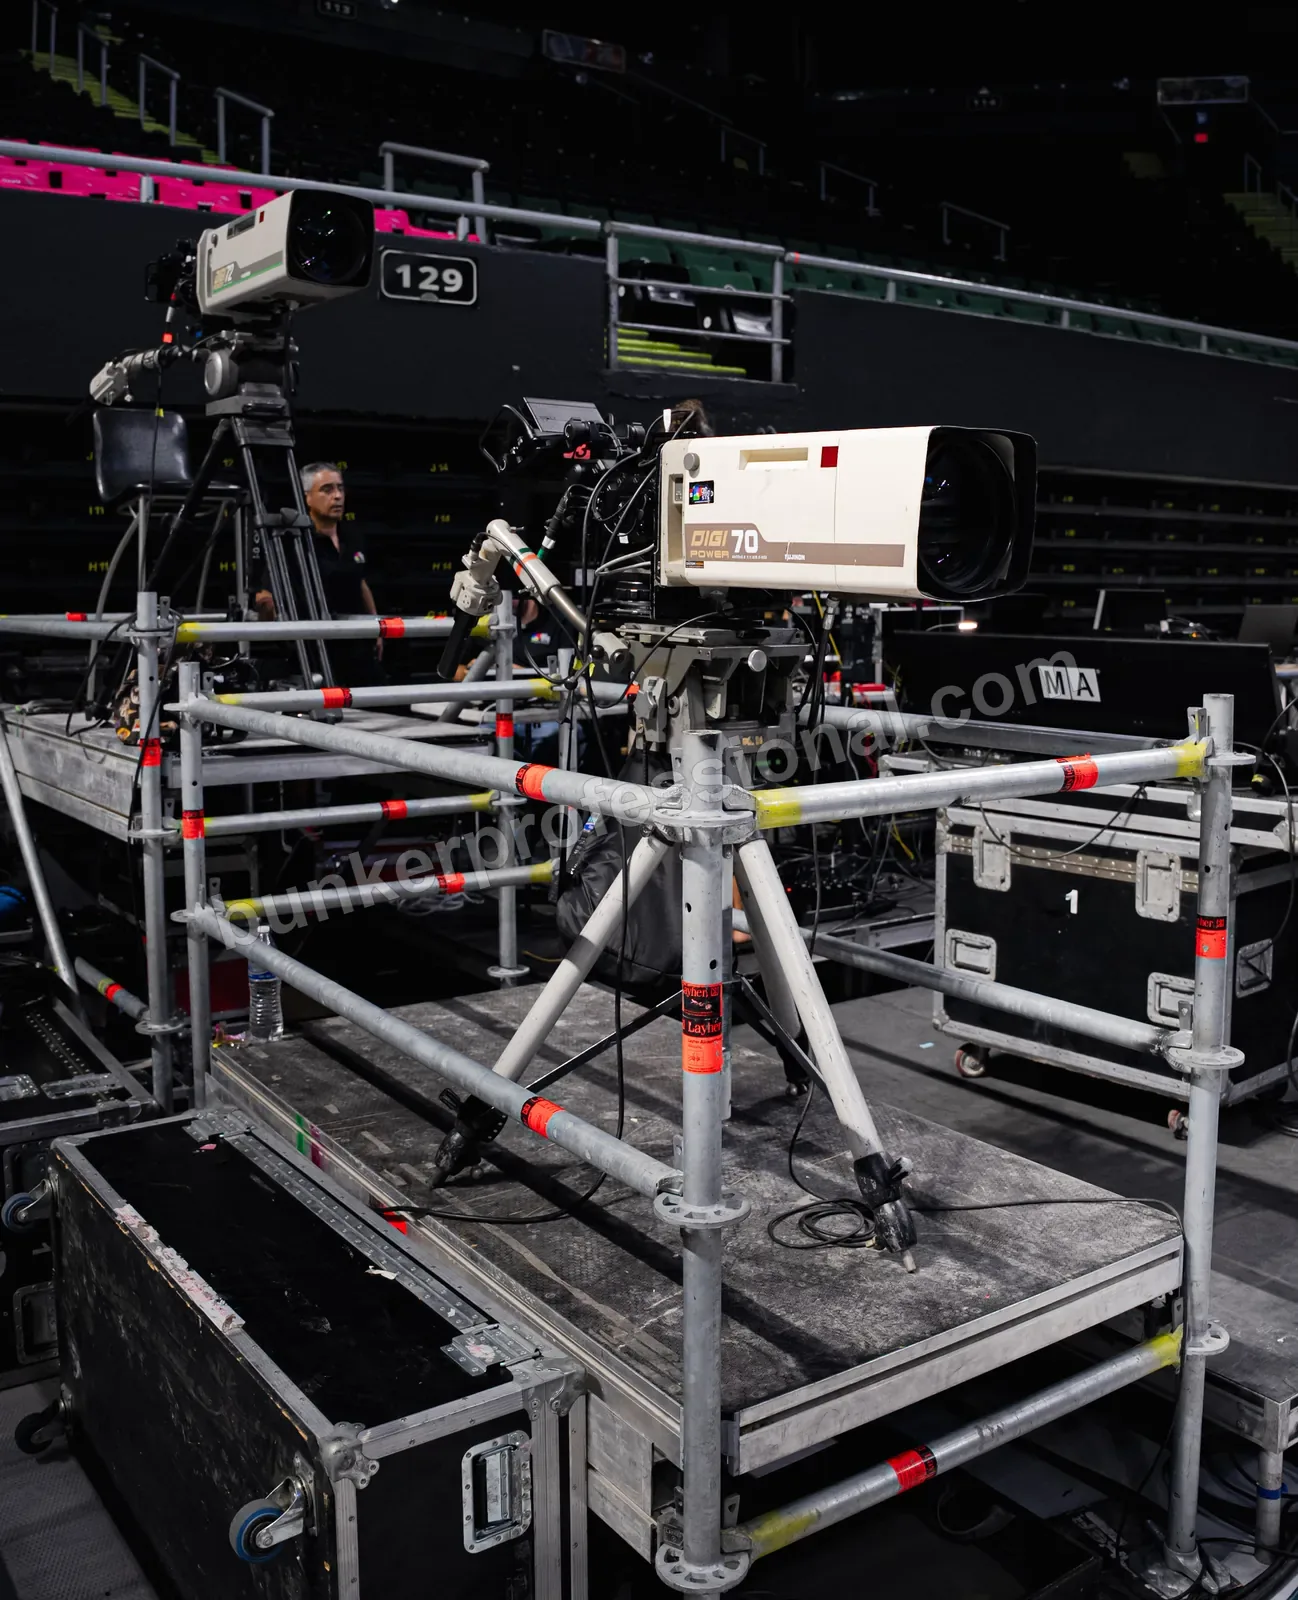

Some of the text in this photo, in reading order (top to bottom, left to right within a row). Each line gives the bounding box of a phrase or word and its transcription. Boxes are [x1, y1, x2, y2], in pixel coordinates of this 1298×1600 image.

[394, 264, 463, 293] 129
[690, 529, 759, 554] DIGI 70
[690, 550, 730, 559] POWER
[1044, 669, 1094, 698] MA
[1065, 889, 1079, 915] 1
